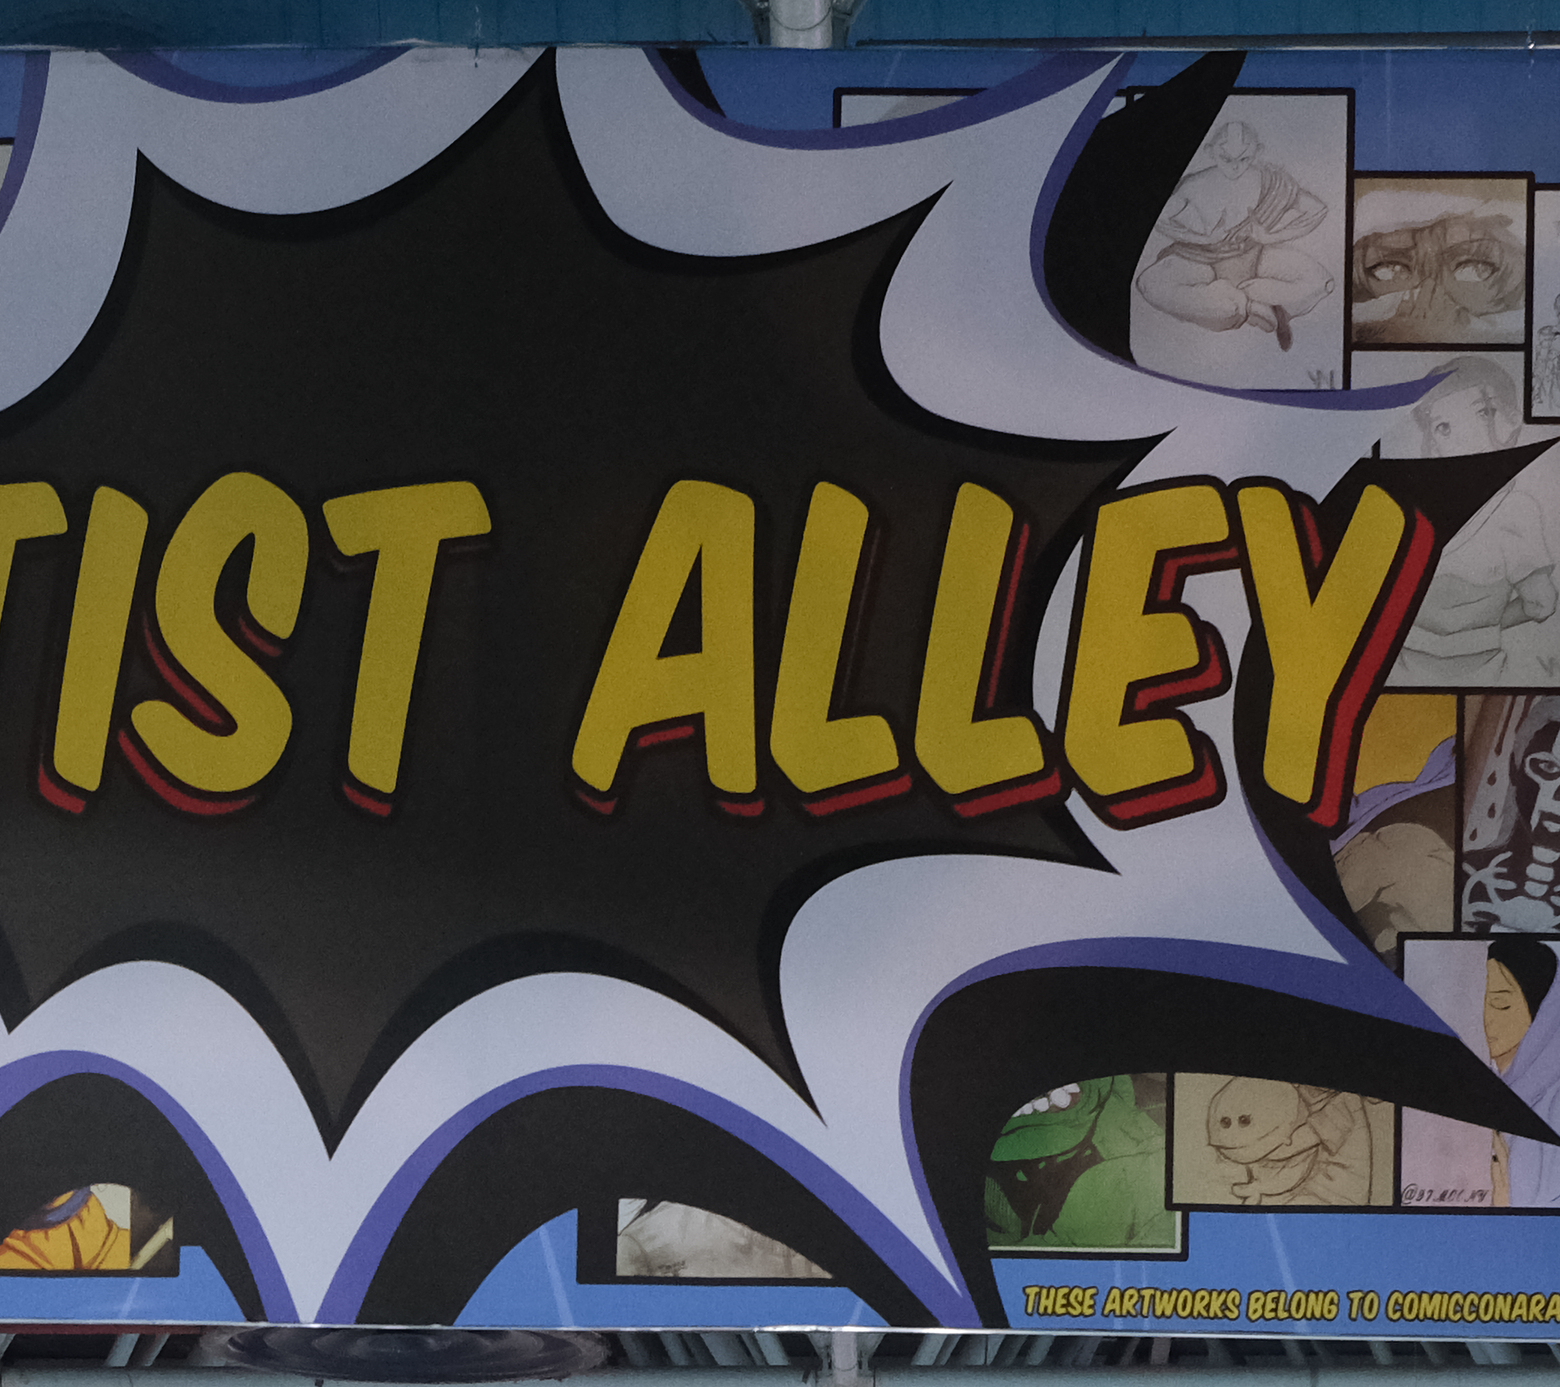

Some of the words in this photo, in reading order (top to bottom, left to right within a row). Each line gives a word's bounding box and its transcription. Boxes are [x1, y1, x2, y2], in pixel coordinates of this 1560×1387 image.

[568, 475, 1433, 830] ALLEY
[1023, 1286, 1098, 1318] THESE
[1102, 1287, 1244, 1320] ARTWORKS
[1246, 1289, 1339, 1323] BELONG
[1347, 1290, 1380, 1321] TO
